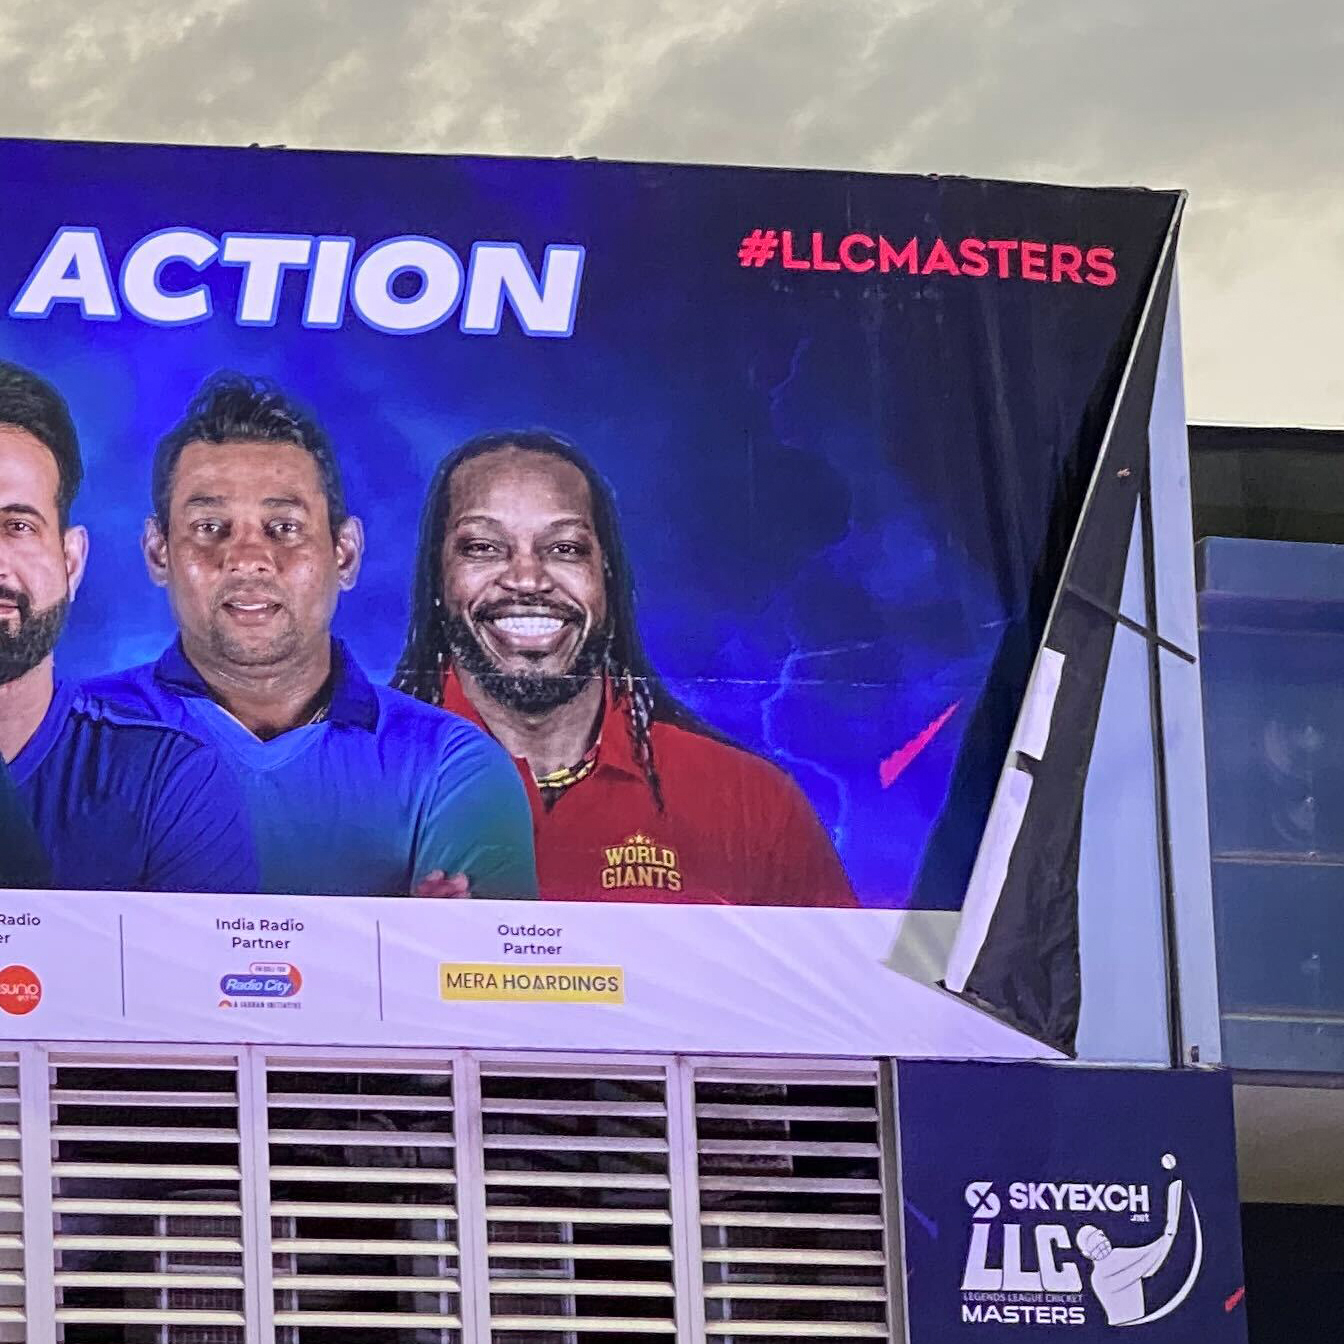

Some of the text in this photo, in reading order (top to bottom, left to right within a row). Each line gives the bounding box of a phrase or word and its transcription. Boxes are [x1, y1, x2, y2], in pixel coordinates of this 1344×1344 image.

[737, 228, 1118, 288] #LLCMASTERS
[9, 225, 586, 336] ACTION
[604, 845, 677, 868] WORLD
[601, 867, 682, 892] GIANTS
[215, 917, 305, 933] India Radio
[497, 923, 563, 938] Outdoor
[231, 936, 291, 951] Partner
[503, 942, 563, 956] Partner
[225, 978, 292, 997] Radio City
[445, 970, 620, 993] MERA HOARDINGS
[1008, 1181, 1150, 1212] SKYEXCH
[960, 1223, 1083, 1292] LLC
[961, 1305, 1086, 1325] MASTERS
